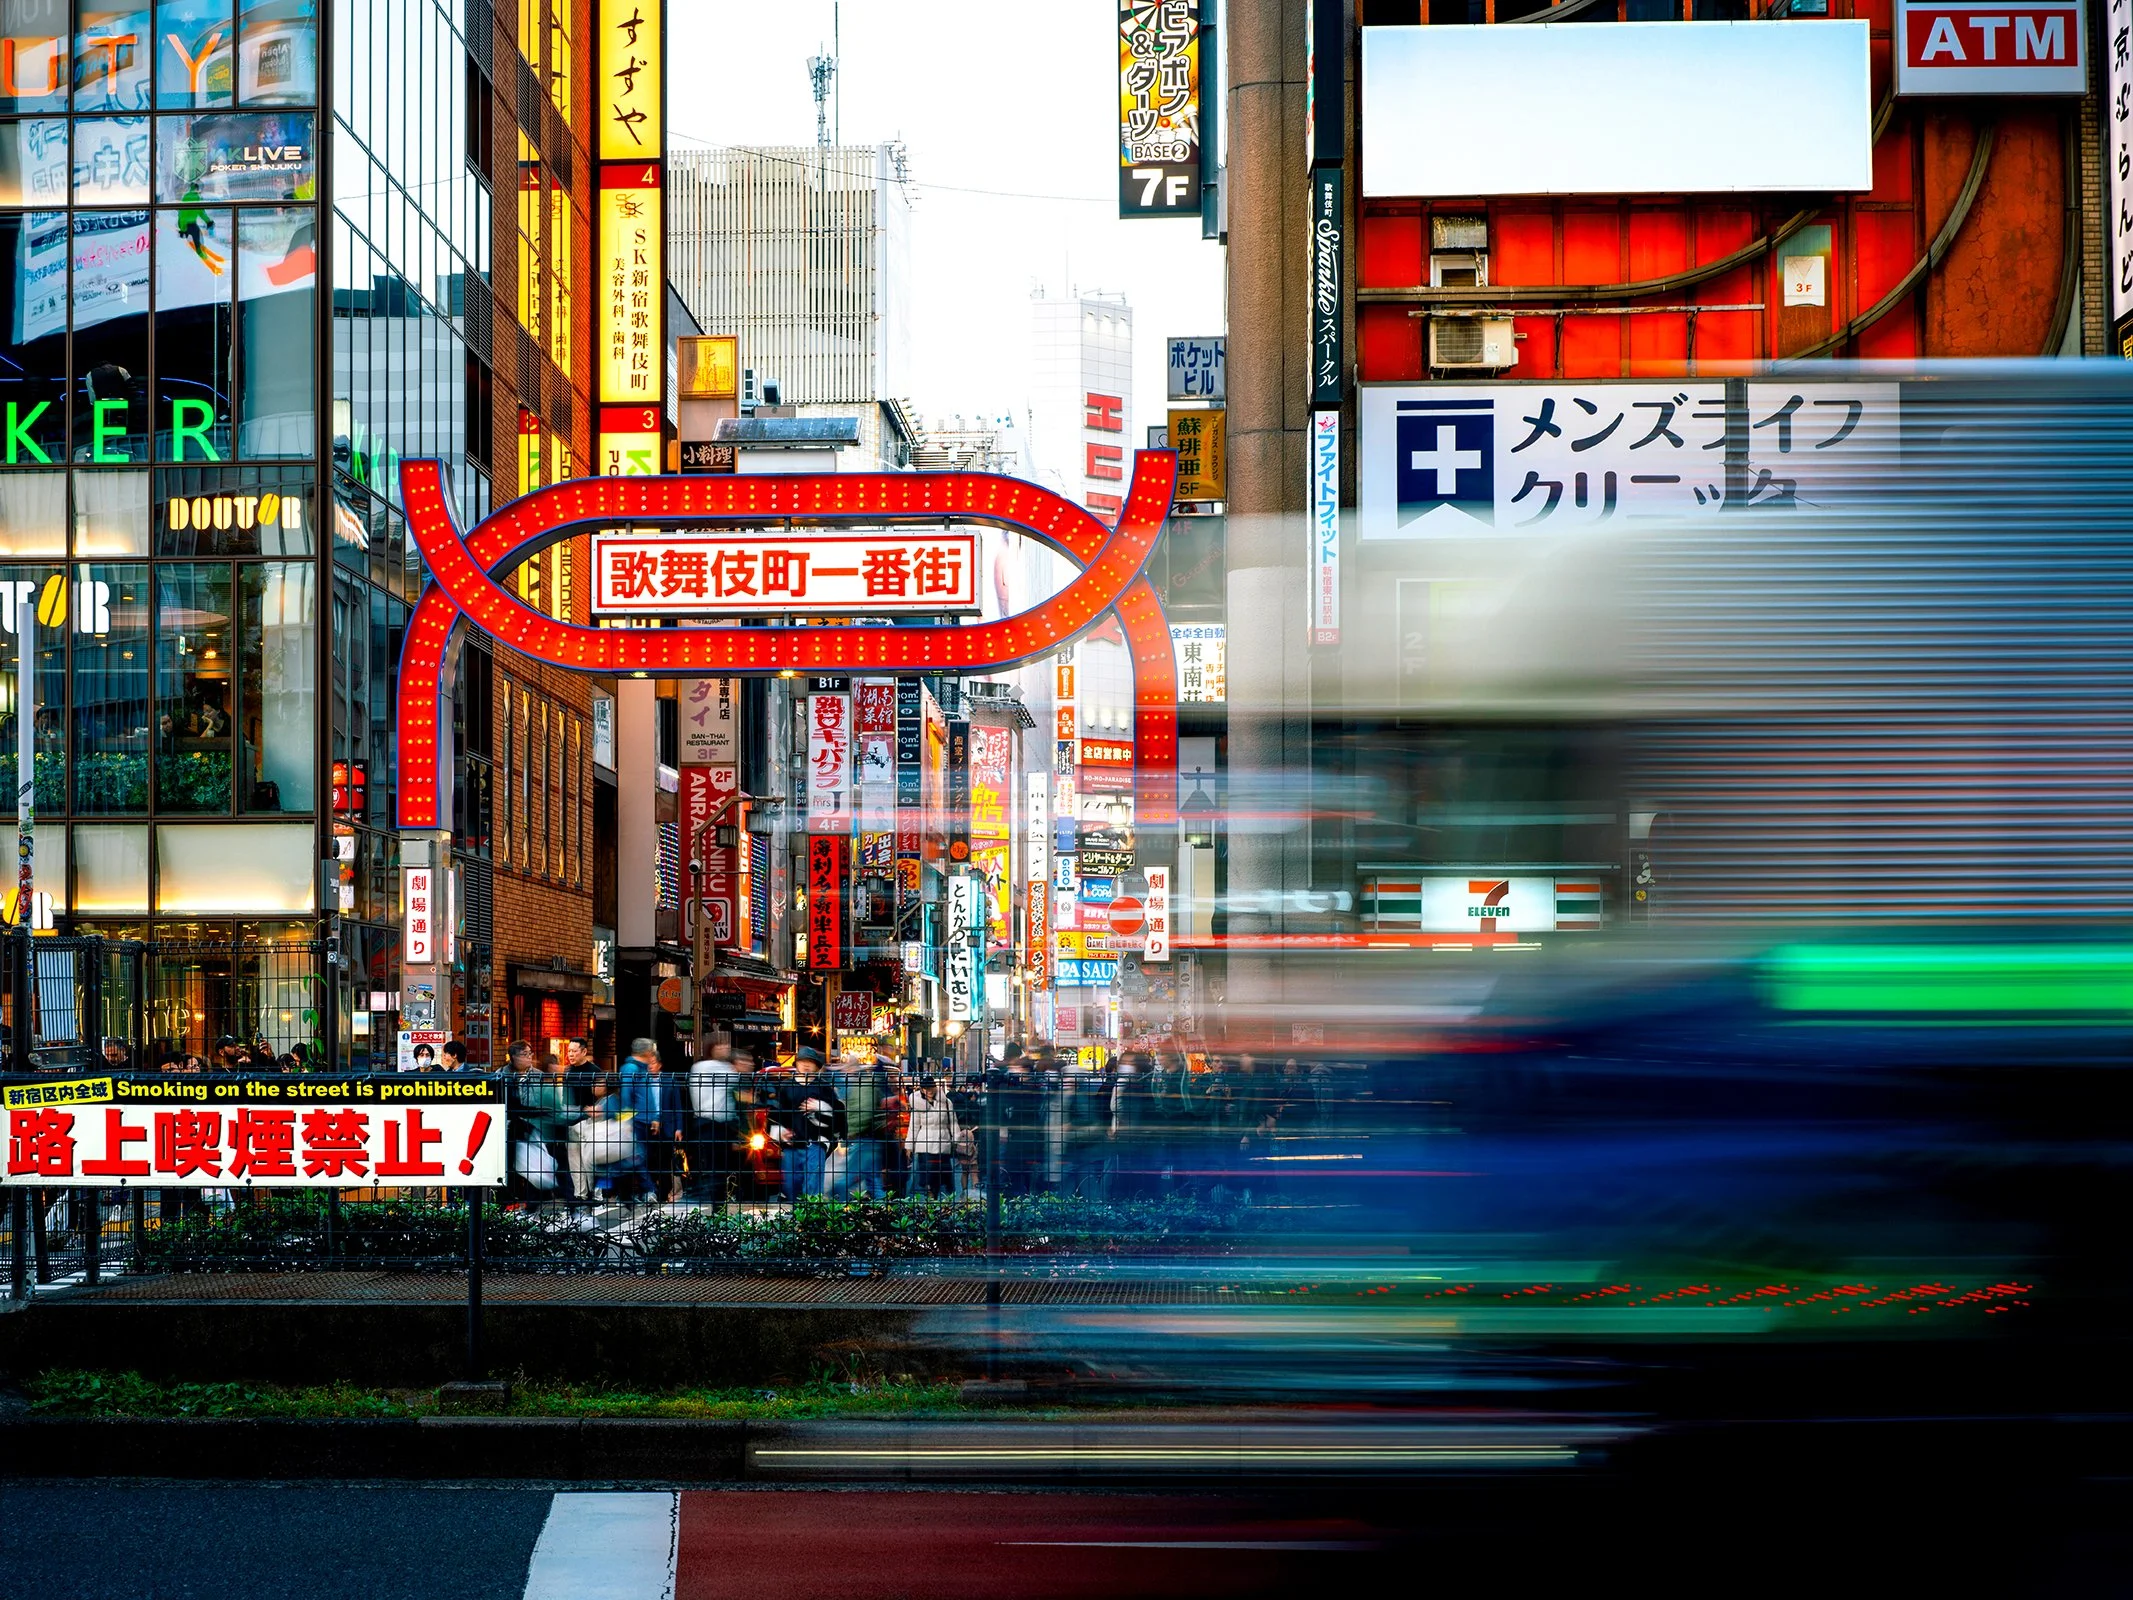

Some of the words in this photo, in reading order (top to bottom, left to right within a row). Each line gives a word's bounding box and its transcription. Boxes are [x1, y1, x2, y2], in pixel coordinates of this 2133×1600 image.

[1921, 16, 2065, 60] ATM
[612, 7, 648, 146] すずや
[641, 166, 655, 184] 4
[1132, 168, 1189, 206] 7F
[1325, 183, 1333, 217] 歌舞伎町
[1171, 341, 1224, 368] ポケット
[1318, 318, 1338, 388] スパークル
[1184, 370, 1214, 395] ビル
[6, 400, 221, 464] KER
[642, 410, 655, 428] 3
[1511, 393, 1863, 453] メンズライフ
[1179, 482, 1200, 495] 5F
[1317, 434, 1337, 563] ファイトフィット
[169, 493, 301, 531] DOUTOR
[610, 547, 962, 599] 歌舞伎町一番街
[1171, 628, 1225, 639] 全卓全自動
[819, 677, 840, 689] B1F
[697, 748, 718, 760] 3F
[1083, 745, 1132, 761] 全店営業中
[715, 771, 732, 783] 2F
[819, 819, 840, 831] 4F
[864, 834, 873, 864] カフェ
[1062, 858, 1071, 885] GiGO
[411, 875, 427, 954] 劇場通り
[1149, 873, 1165, 954] 劇場通り
[1059, 962, 1080, 978] PA
[1081, 961, 1117, 978] SAUN
[8, 1082, 108, 1106] 新宿区内全域
[117, 1081, 207, 1099] Smoking
[215, 1084, 239, 1097] on
[247, 1081, 280, 1097] the
[287, 1083, 349, 1097] street
[356, 1081, 373, 1097] is
[381, 1080, 494, 1101] prohibited.
